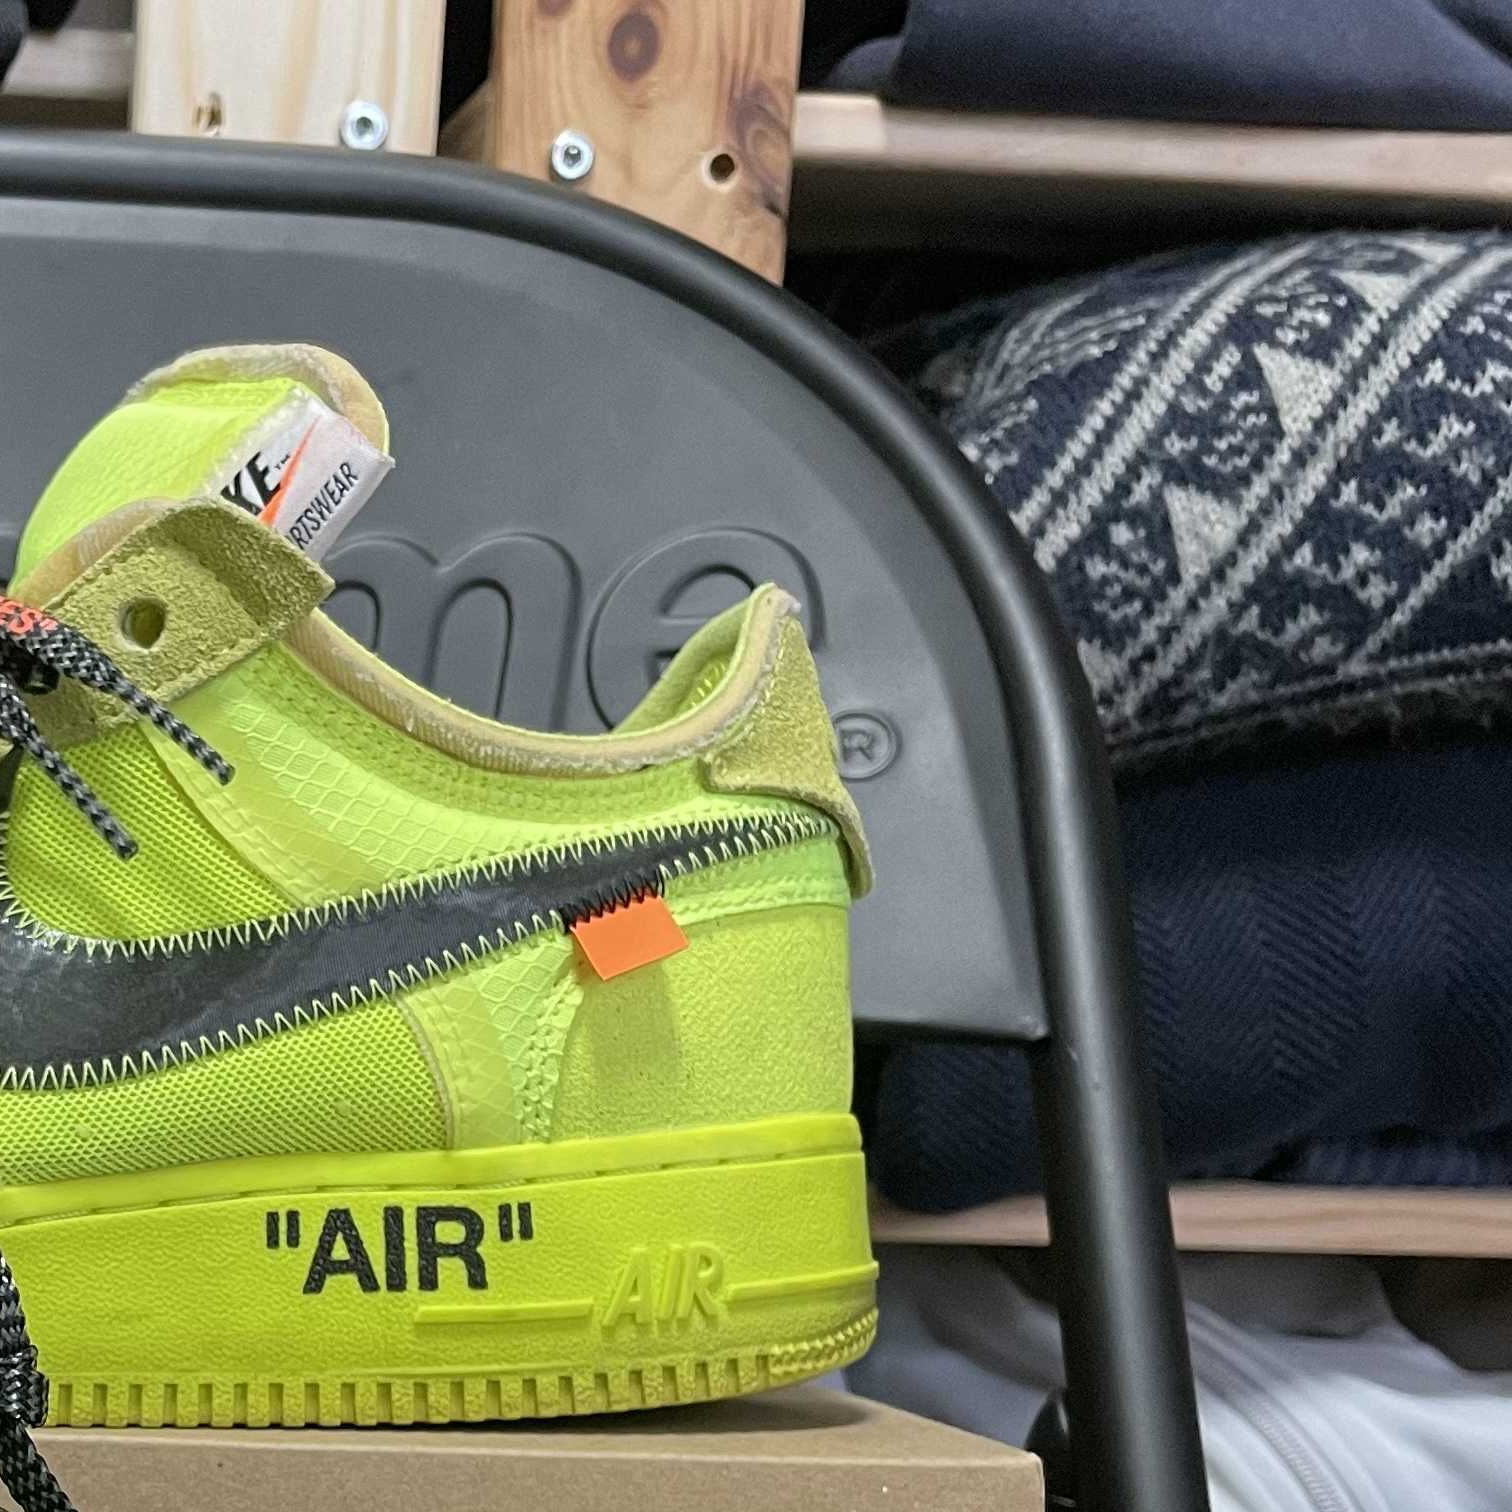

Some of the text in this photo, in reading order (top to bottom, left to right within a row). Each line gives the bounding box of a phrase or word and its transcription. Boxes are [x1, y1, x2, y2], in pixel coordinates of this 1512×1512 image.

[220, 451, 282, 516] KE
[287, 461, 360, 551] RTSWEAR
[265, 1201, 534, 1295] "AIR"
[600, 1240, 726, 1331] AIR
